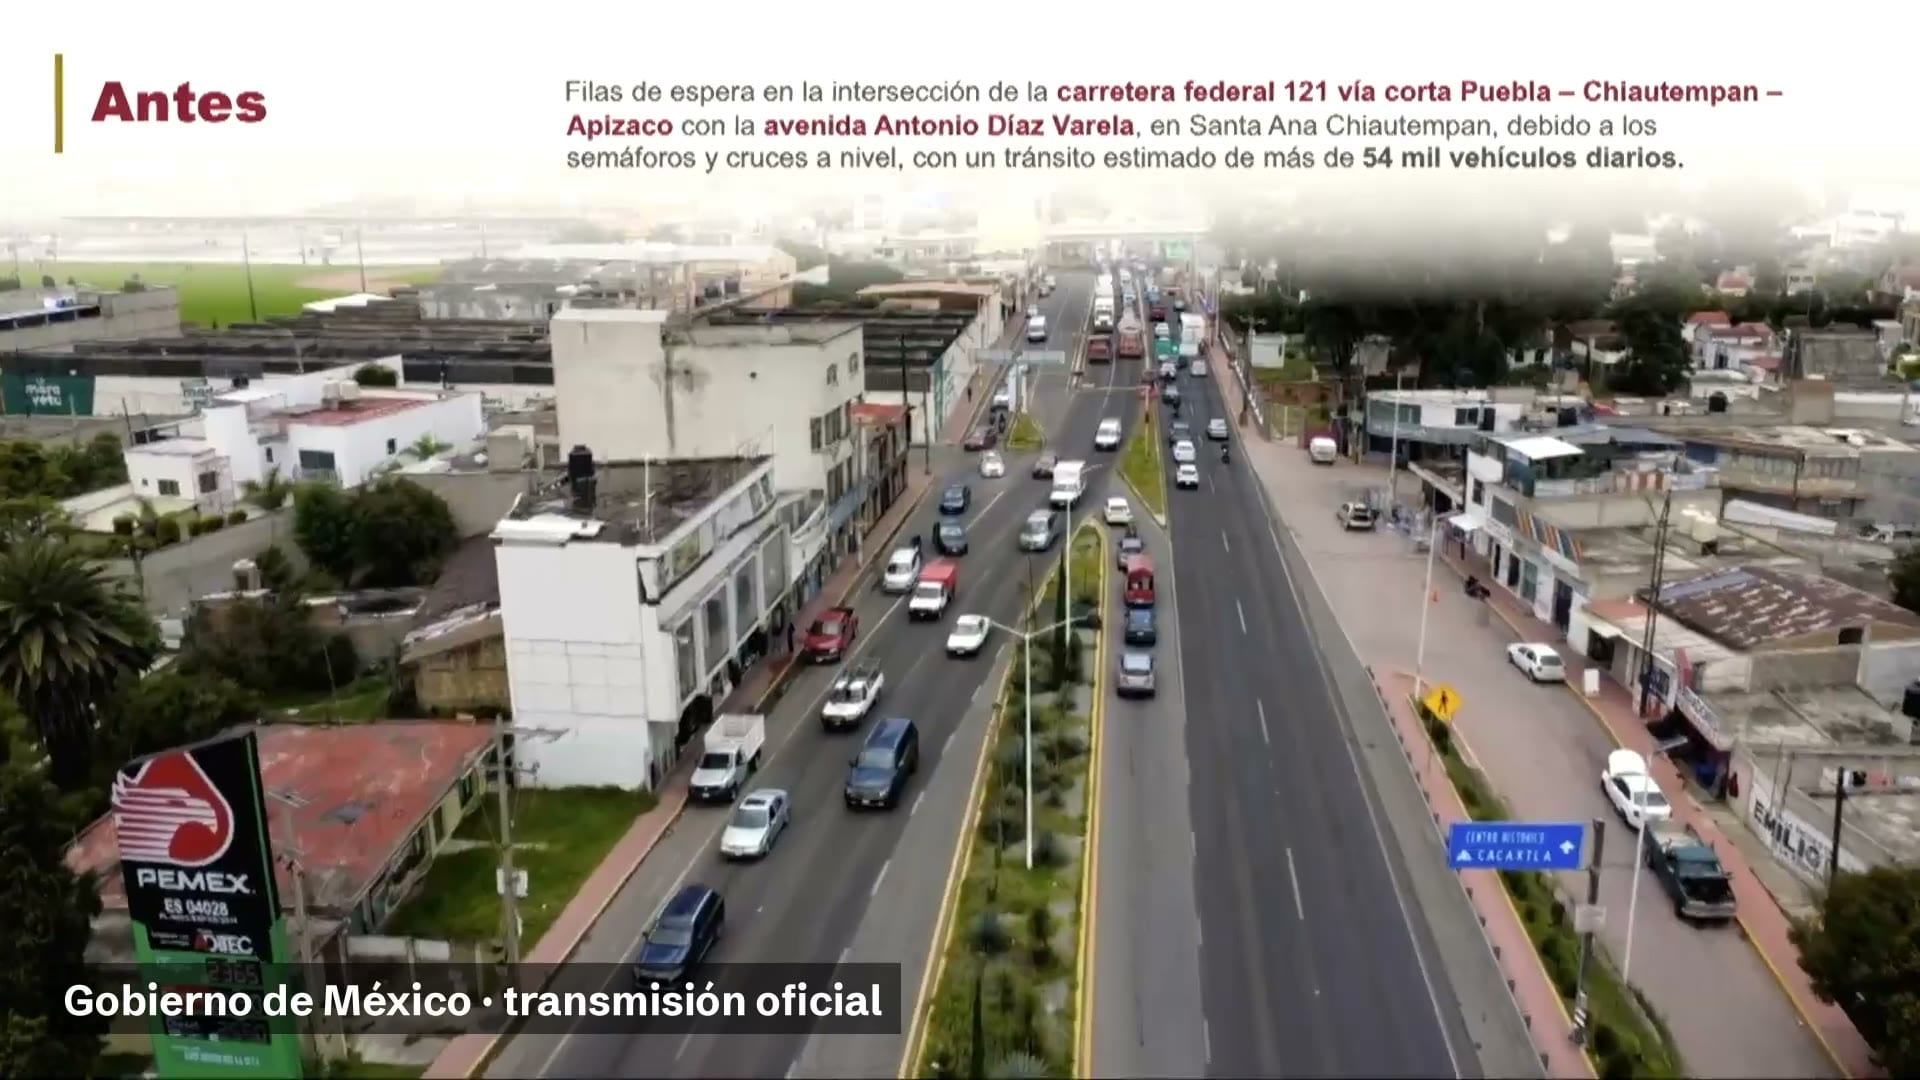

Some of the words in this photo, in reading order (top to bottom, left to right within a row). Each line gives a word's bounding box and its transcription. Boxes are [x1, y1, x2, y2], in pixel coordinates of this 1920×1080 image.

[1465, 831, 1498, 844] CENTRO
[1478, 849, 1552, 862] CACAXTLA
[136, 868, 250, 894] PEMEX
[186, 899, 229, 917] 04028
